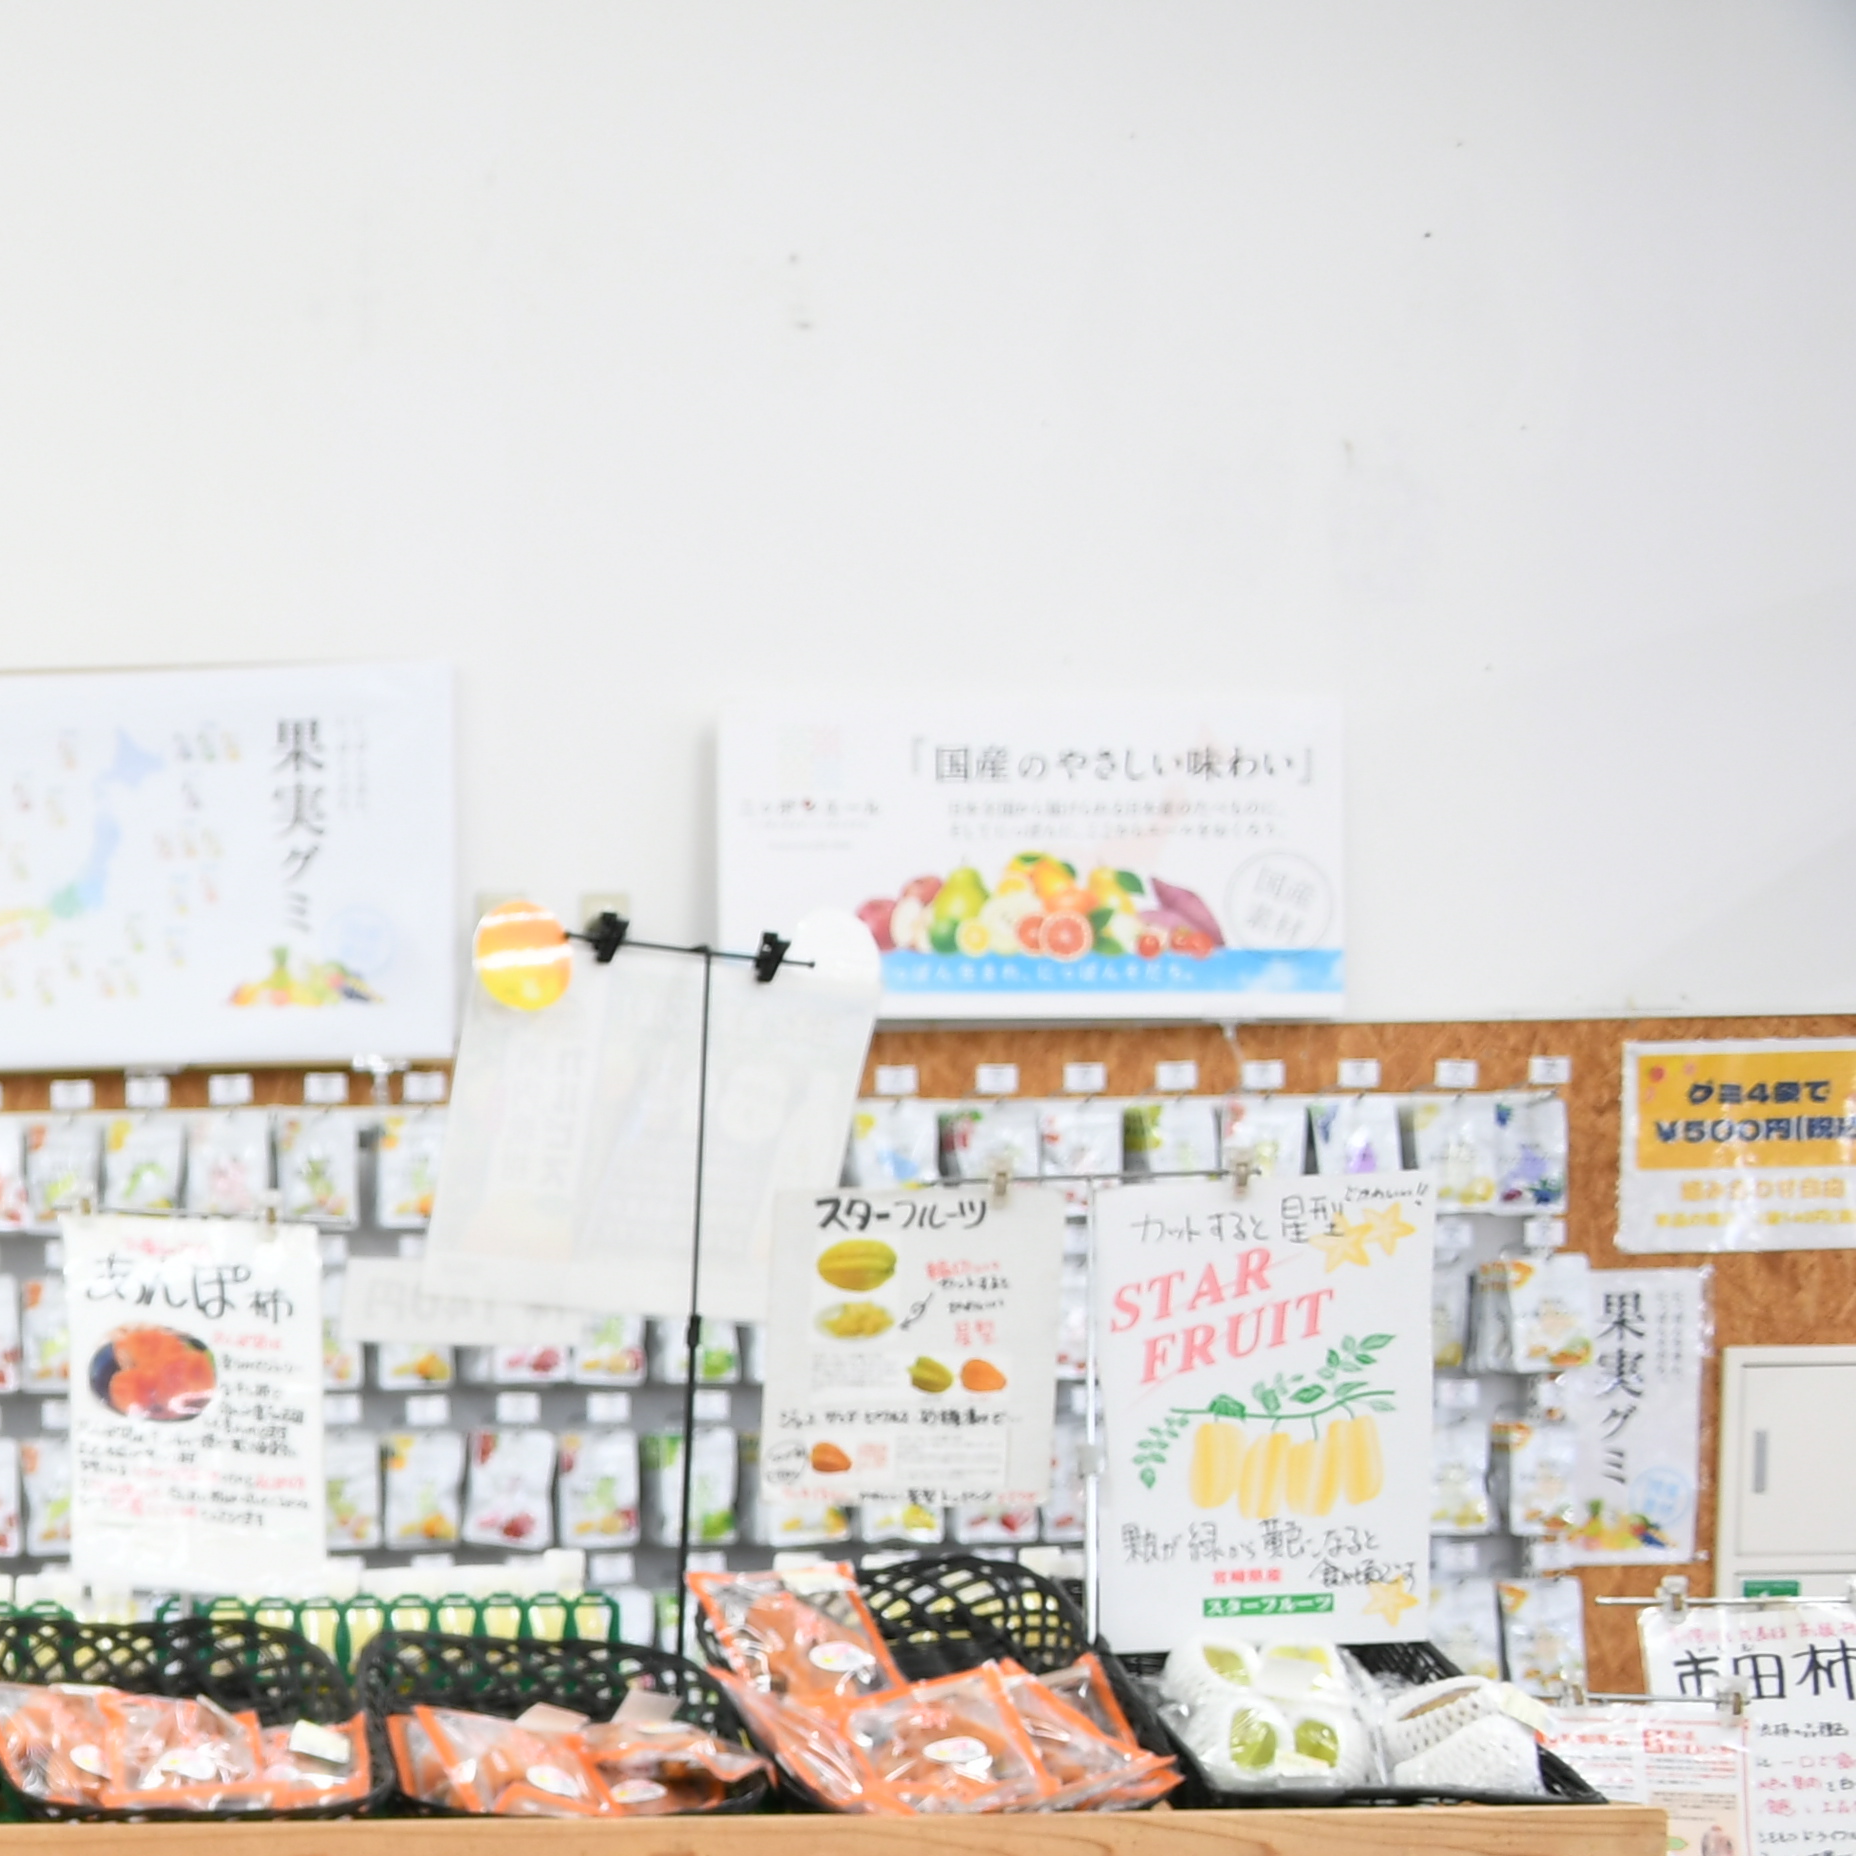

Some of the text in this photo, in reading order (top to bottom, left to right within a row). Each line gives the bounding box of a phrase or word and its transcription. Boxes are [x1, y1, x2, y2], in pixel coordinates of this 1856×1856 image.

[273, 716, 324, 934] 果実グミ
[815, 1197, 987, 1232] スターフルーツ
[85, 1252, 294, 1324] あんぽ柿
[1110, 1246, 1273, 1334] STAR
[1139, 1288, 1335, 1386] FRUIT
[1595, 1290, 1646, 1486] 果実グミ
